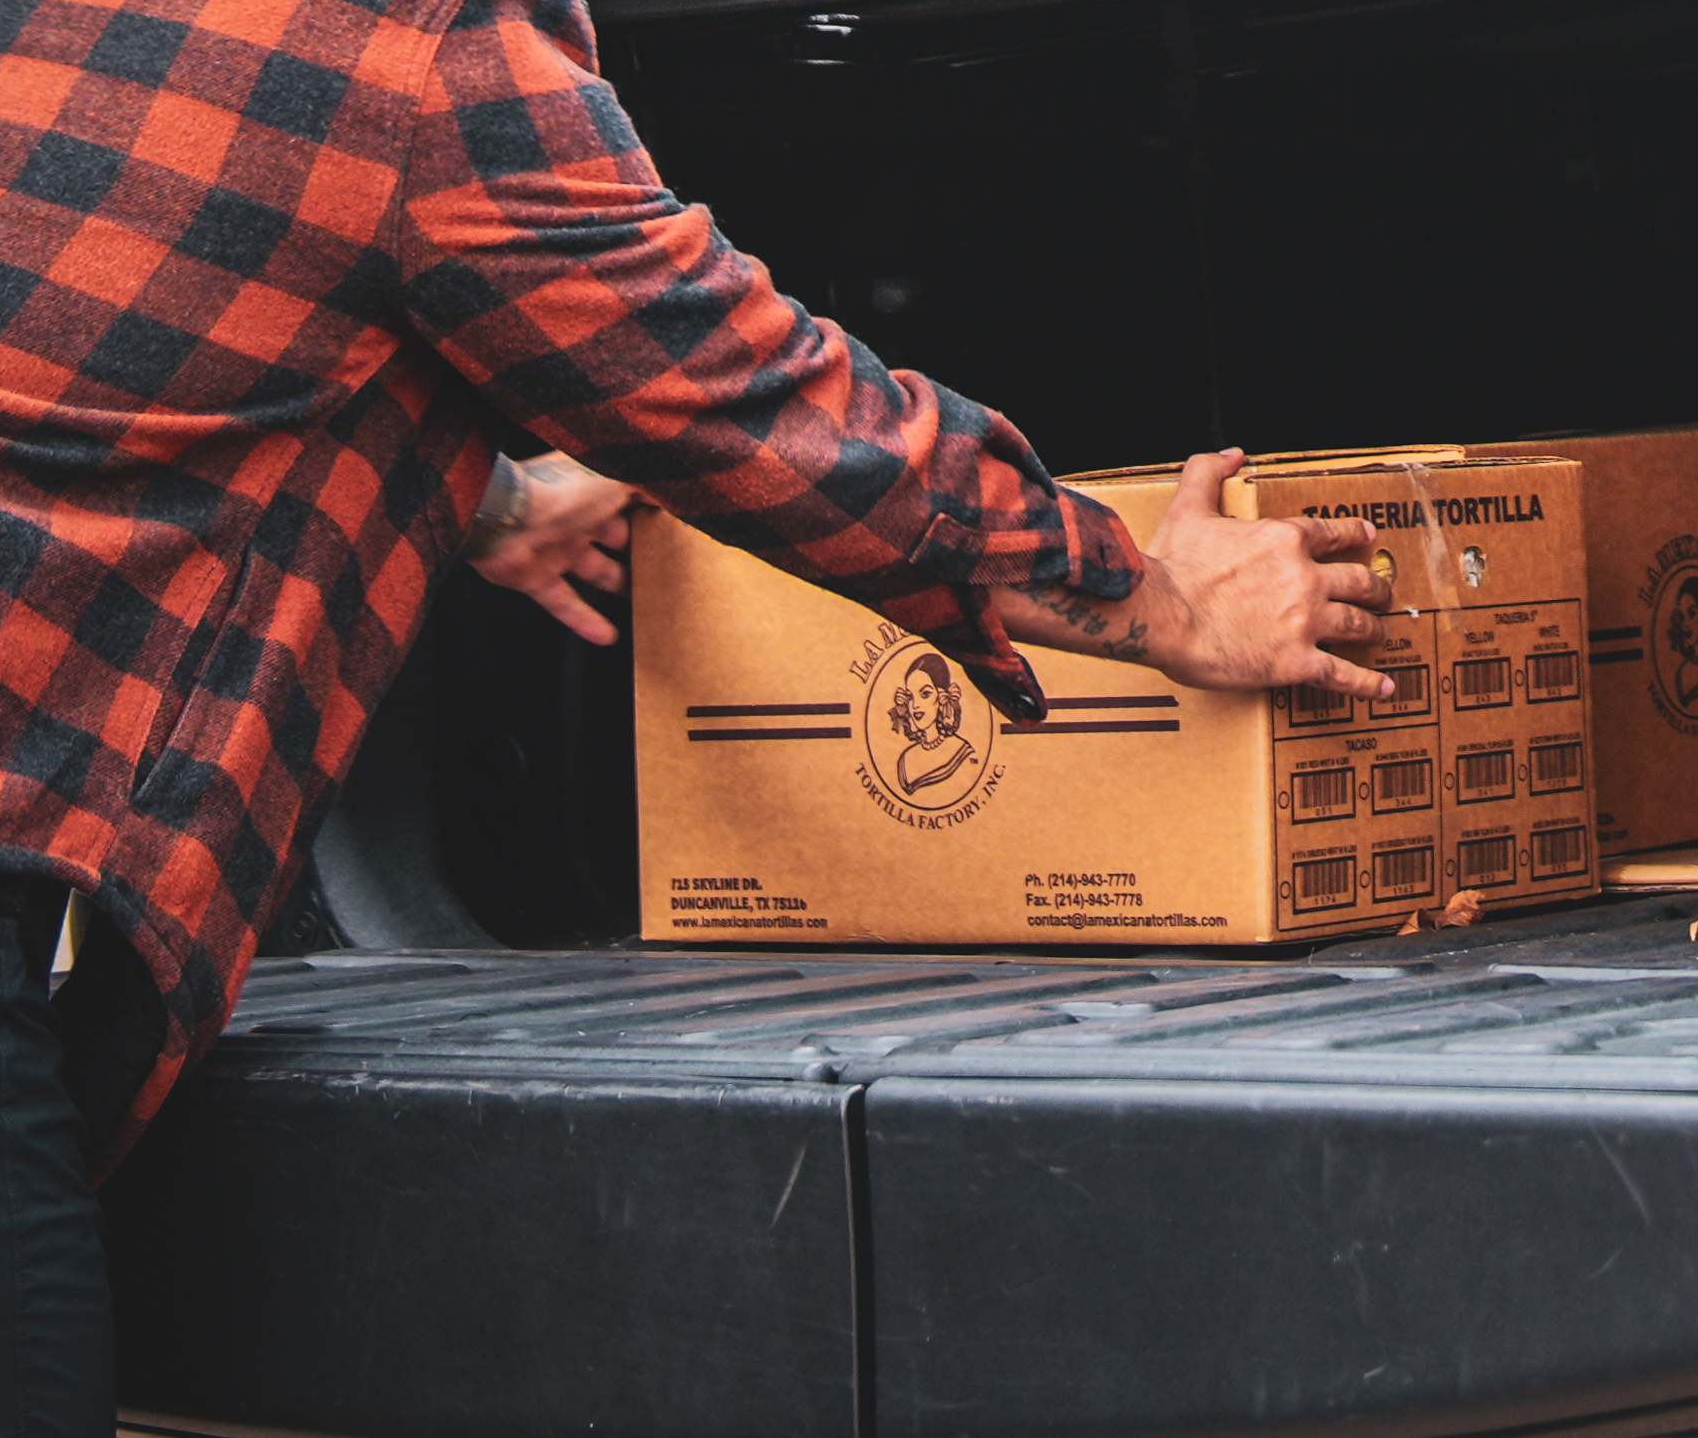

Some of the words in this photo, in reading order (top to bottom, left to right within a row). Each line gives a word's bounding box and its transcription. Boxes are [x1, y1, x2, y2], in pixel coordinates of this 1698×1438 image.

[1432, 493, 1544, 526] TORTILLA
[849, 639, 885, 684] LA
[1345, 737, 1378, 752] TACASO
[855, 763, 916, 827] TORTILLA
[918, 795, 987, 830] FACTORY,
[693, 878, 740, 890] SKYLINE
[742, 878, 762, 890] DR.
[1025, 873, 1044, 887] Ph.
[1048, 873, 1136, 890] (214)-943-7770
[671, 897, 754, 912] DUNCANVILLE,
[755, 897, 770, 910] TX
[1025, 893, 1051, 907] Fax.
[1055, 893, 1143, 910] (214)-943-7778
[1027, 913, 1228, 930] contact@lamexicanatortillas.com
